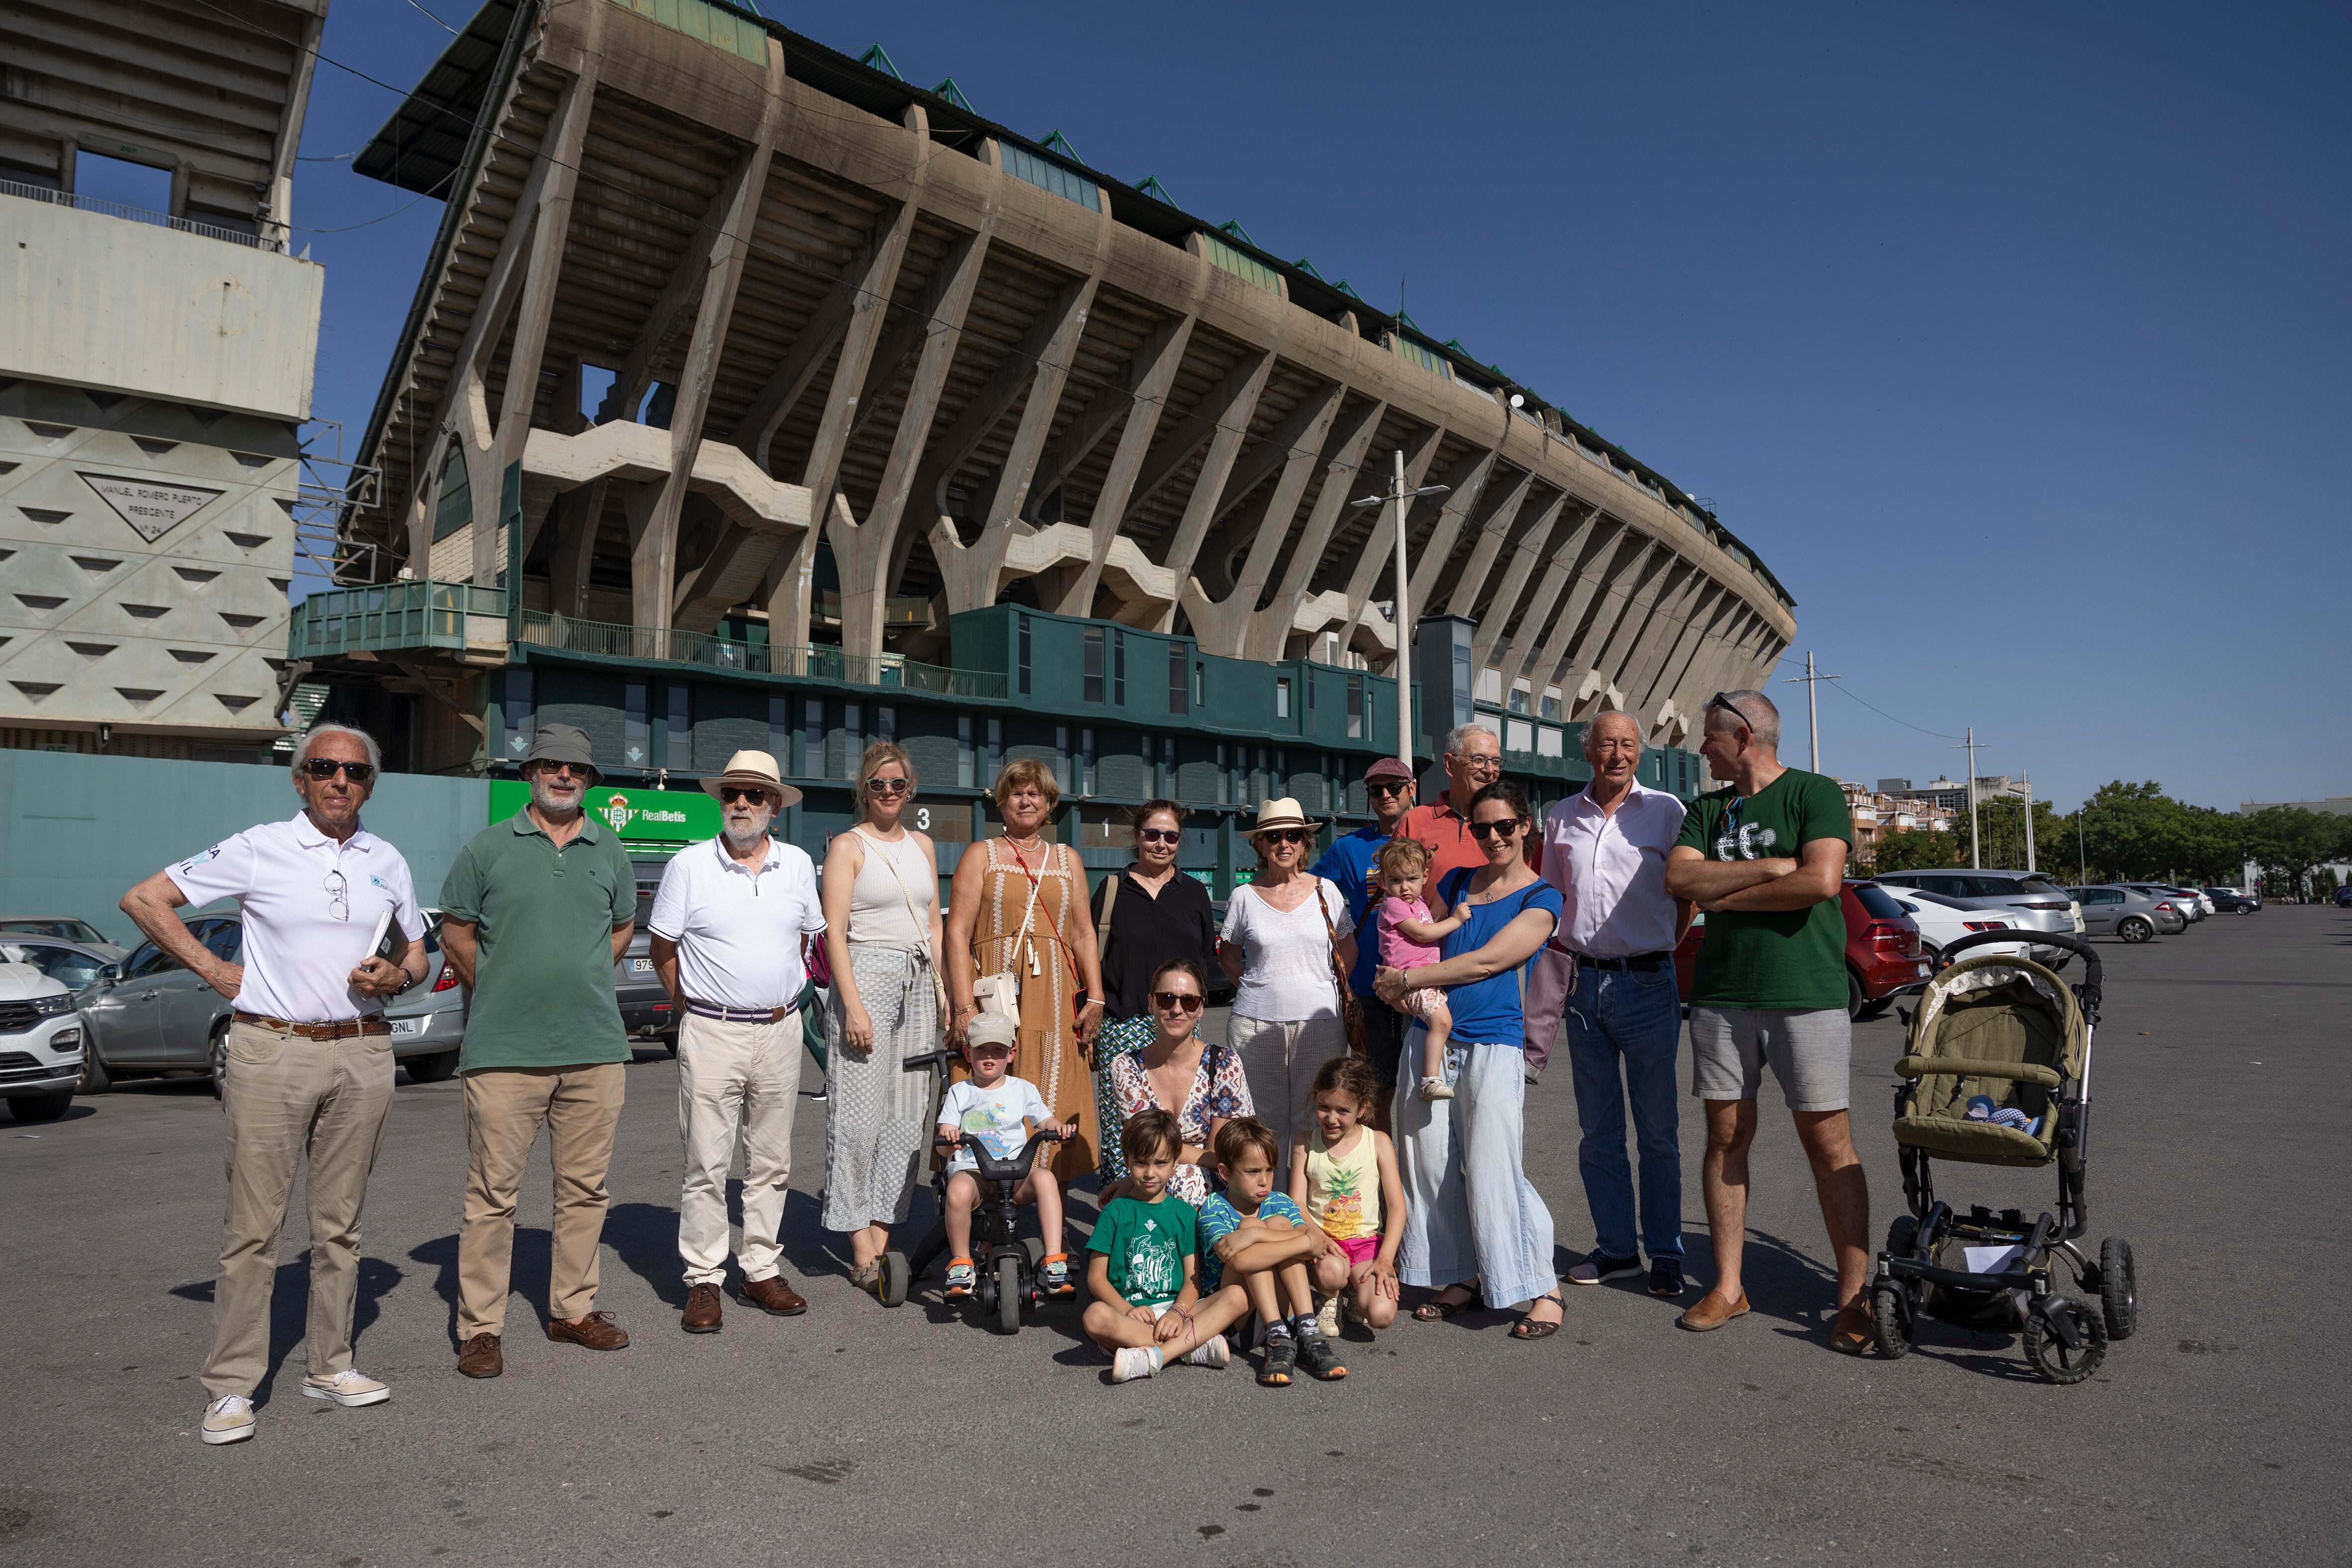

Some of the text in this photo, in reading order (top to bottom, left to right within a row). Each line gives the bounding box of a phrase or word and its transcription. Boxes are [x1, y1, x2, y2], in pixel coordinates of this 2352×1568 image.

[101, 485, 202, 506] MANUEL ROMERO PUERTO
[128, 505, 175, 519] PRESIDENTE
[151, 526, 162, 534] 24
[642, 809, 686, 822] RealBetis
[917, 808, 930, 830] 3
[1101, 818, 1109, 837] 1
[179, 860, 193, 875] IL
[391, 1021, 413, 1033] GNL
